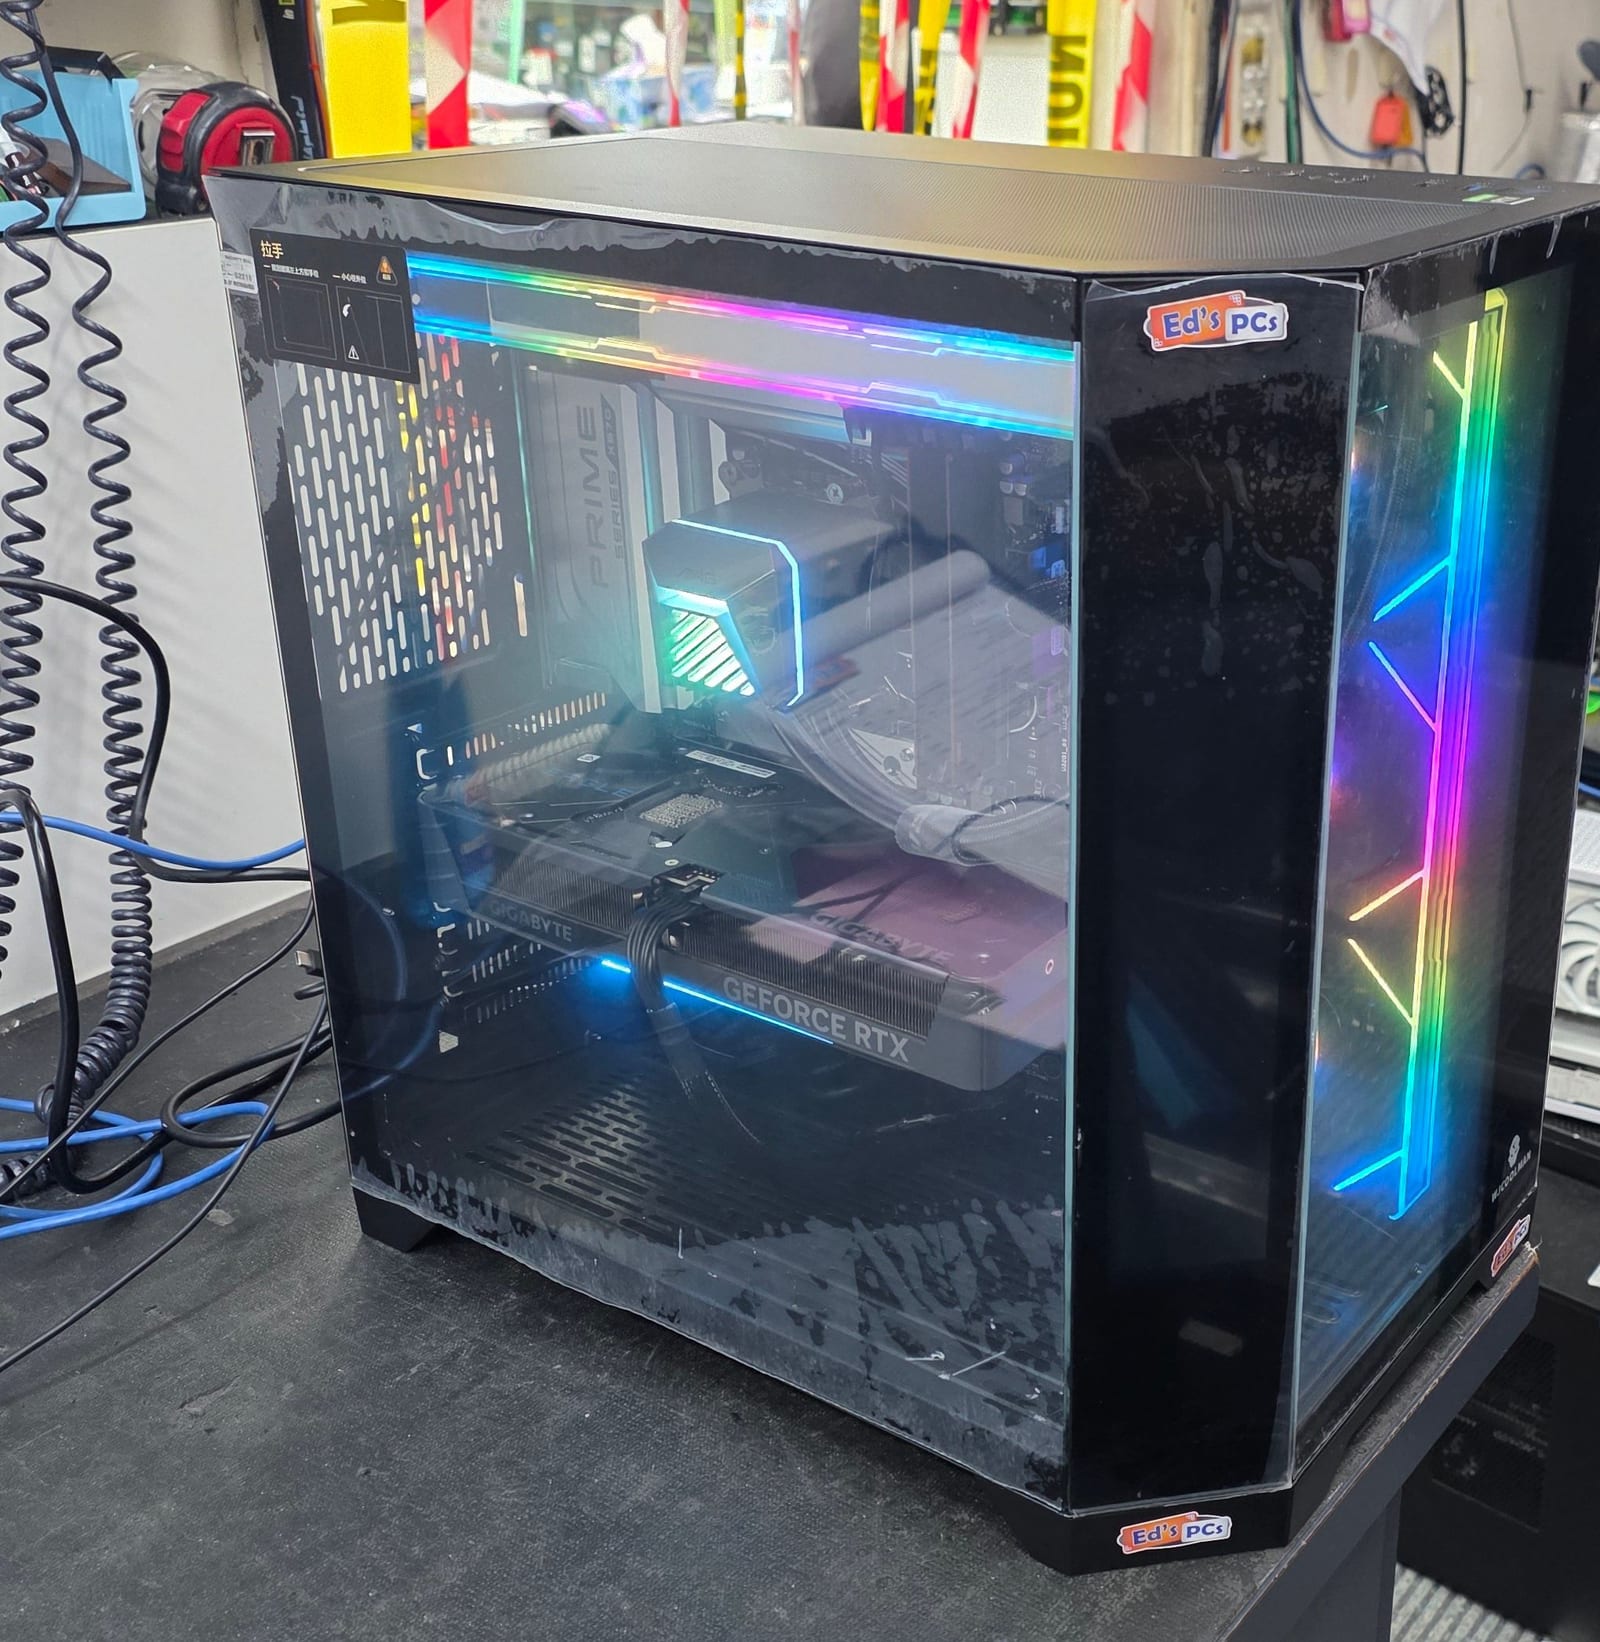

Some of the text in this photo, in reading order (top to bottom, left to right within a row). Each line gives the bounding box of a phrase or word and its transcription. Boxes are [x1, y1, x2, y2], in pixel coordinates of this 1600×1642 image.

[260, 240, 284, 259] 拉手
[1163, 306, 1278, 338] Ed's PCs
[576, 405, 609, 588] PRIME
[608, 469, 625, 559] SERIES
[490, 902, 573, 943] GIGABYTE
[810, 912, 955, 960] GIGABYTE
[723, 976, 910, 1063] GEFORCE RTX
[1133, 1523, 1223, 1545] Ed's PCs
